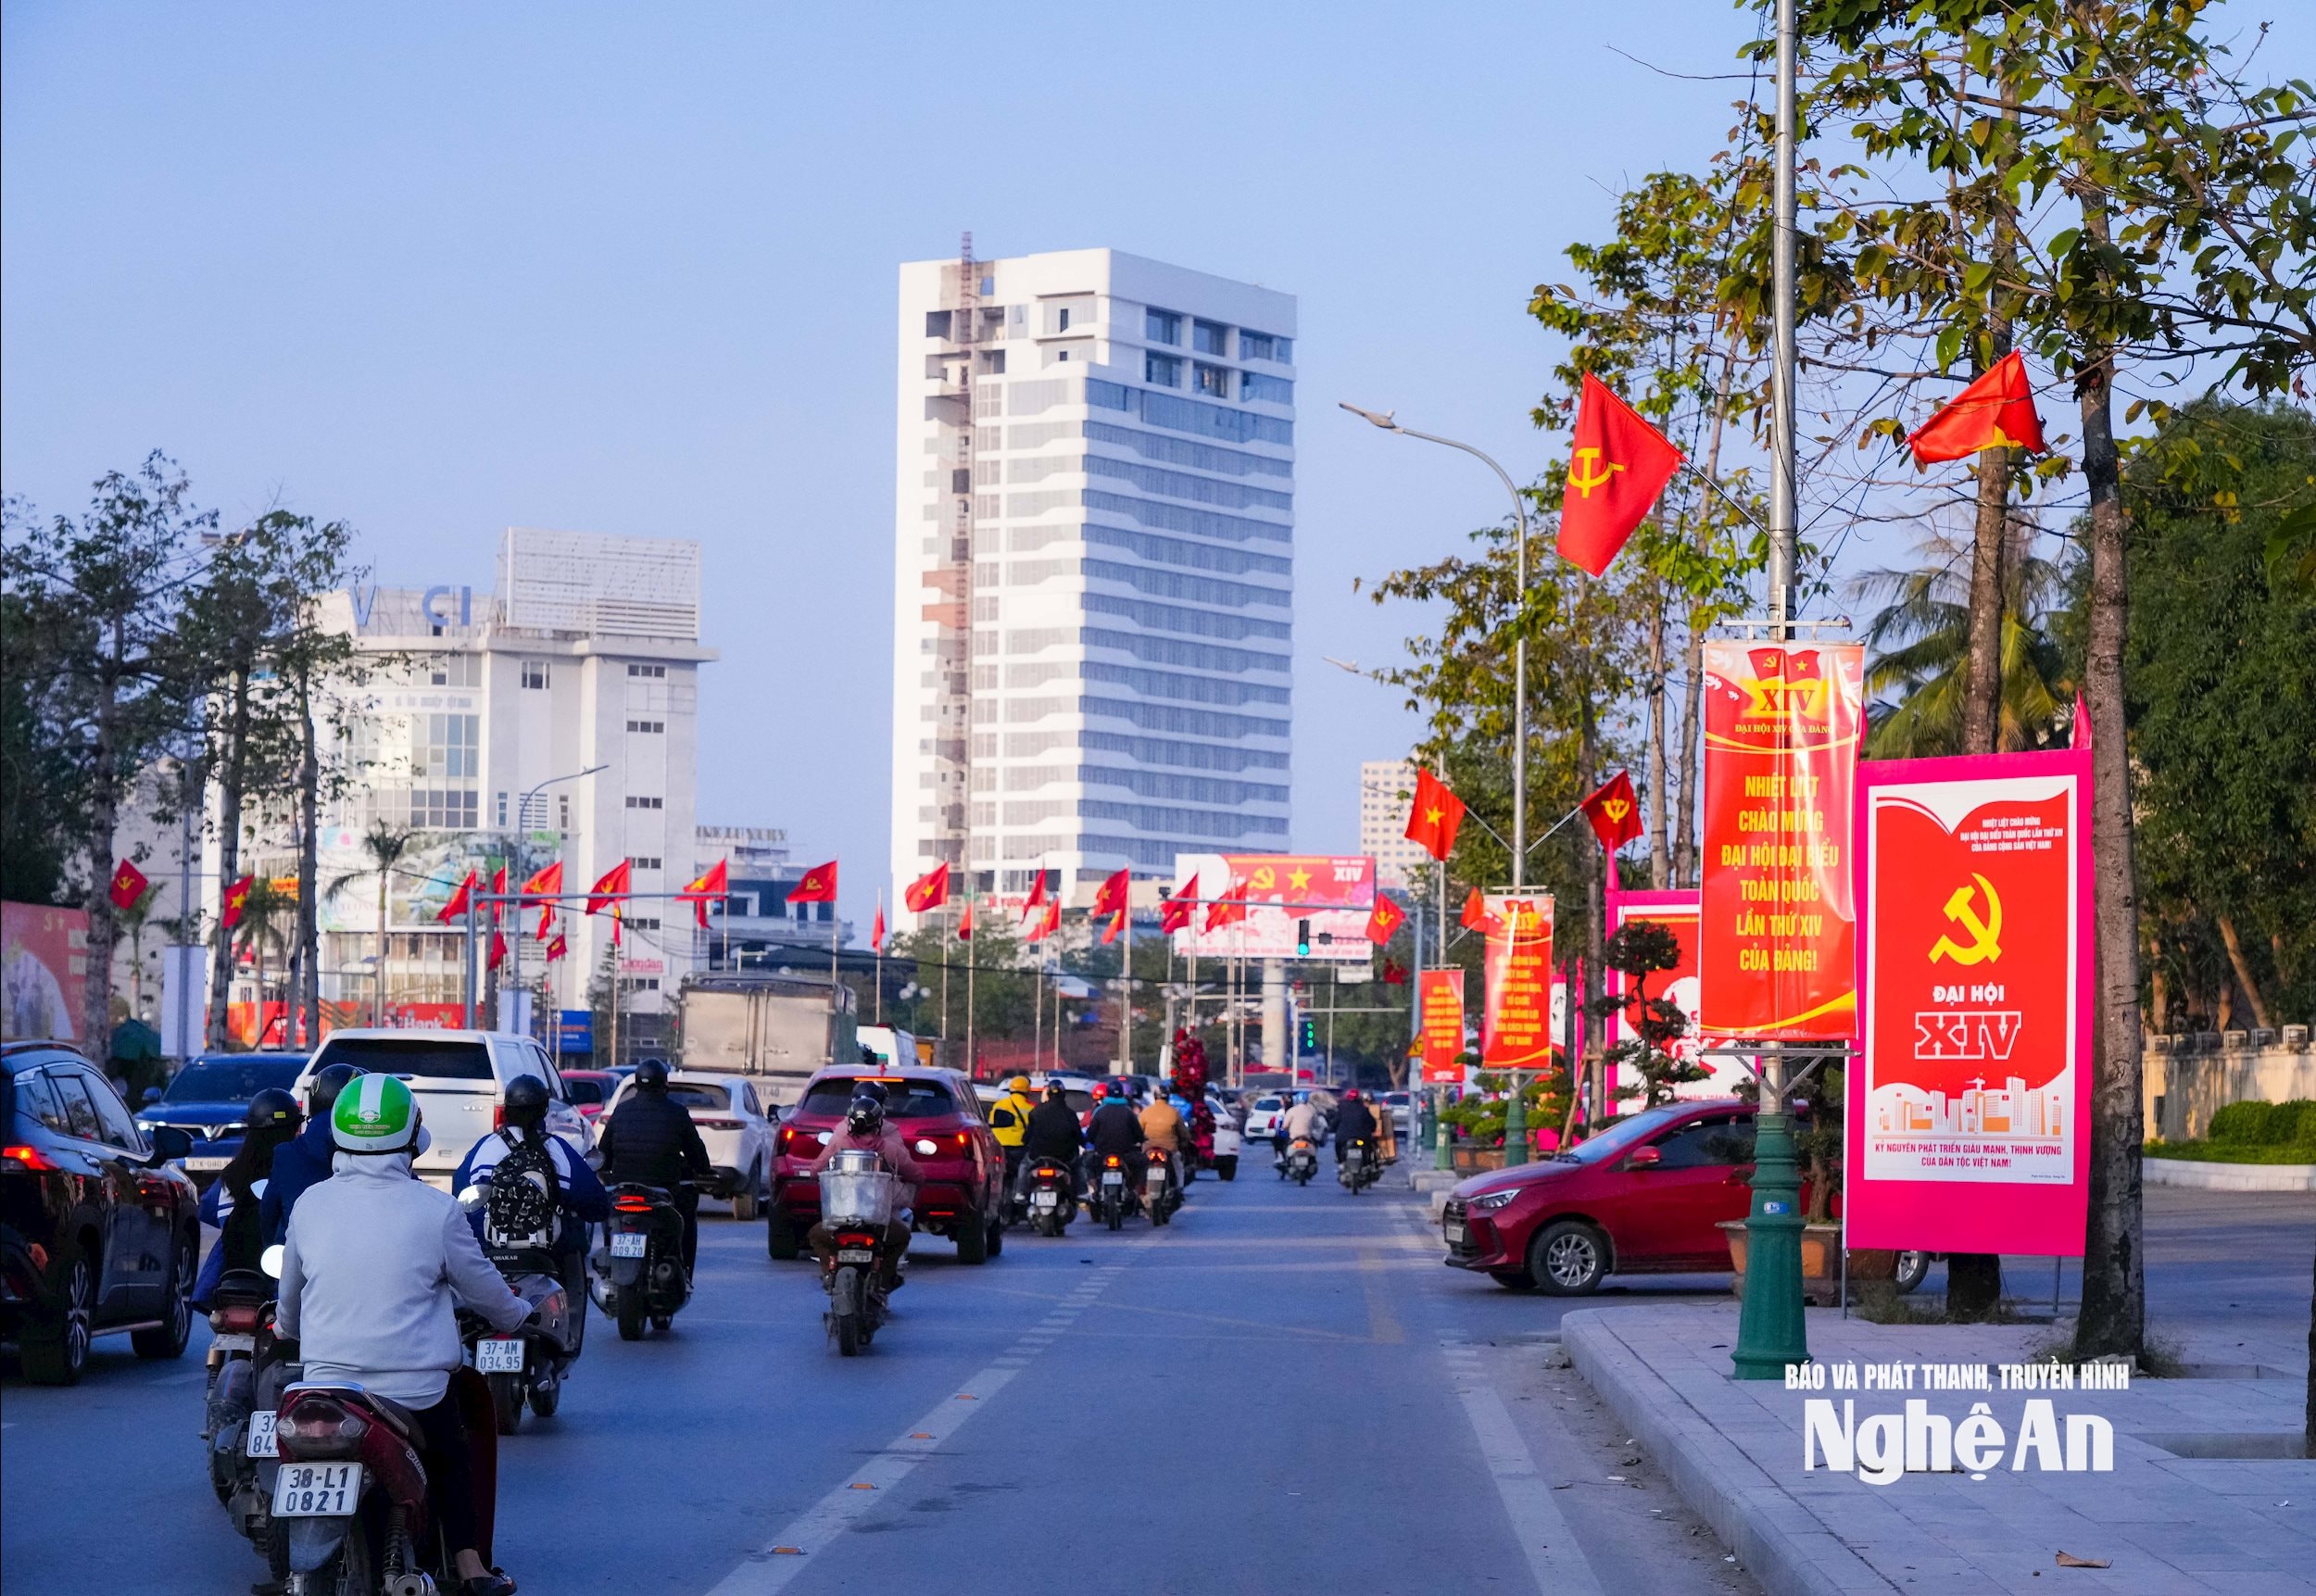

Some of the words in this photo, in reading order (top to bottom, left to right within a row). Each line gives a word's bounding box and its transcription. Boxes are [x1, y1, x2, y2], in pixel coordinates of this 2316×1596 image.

[1760, 689, 1815, 711] XIV
[1735, 724, 1751, 734] ĐẠI
[1754, 723, 1770, 735] HỘI
[1745, 772, 1786, 802] NHIỆT
[1739, 806, 1778, 832] CHÀO
[1721, 845, 1746, 871] ĐẠI
[1751, 841, 1776, 872] HỘI
[1779, 845, 1802, 872] ĐẠI
[1334, 867, 1363, 882] XIV
[1740, 875, 1778, 901] TOÀN
[1781, 873, 1819, 904] QUỐC
[1736, 908, 1765, 936] LẦN
[1769, 911, 1797, 936] THỨ
[1800, 915, 1822, 936] XIV
[1740, 942, 1769, 971] CỦA
[1773, 943, 1817, 972] ĐẢNG!
[1932, 985, 1965, 1006] ĐẠI
[1970, 981, 2005, 1006] HỘI
[1915, 1011, 2021, 1060] XIV
[1875, 1140, 1884, 1152] KỶ
[1887, 1141, 1916, 1152] NGUYÊN
[1919, 1142, 1937, 1152] PHÁT
[1940, 1140, 1960, 1153] TRIỂN
[1963, 1143, 1981, 1153] GIÀU
[1983, 1145, 2008, 1156] MẠNH,
[2010, 1145, 2033, 1156] THỊNH
[2035, 1145, 2061, 1157] VƯỢNG
[1921, 1153, 1936, 1166] CỦA
[1939, 1155, 1954, 1166] DÂN
[1957, 1156, 1970, 1168] TỘC
[1972, 1156, 1988, 1169] VIỆT
[1991, 1158, 2011, 1168] NAM!
[613, 1246, 643, 1256] 009.20
[616, 1235, 641, 1246] 37-AH
[485, 1342, 518, 1355] 37-AM
[480, 1357, 520, 1369] 034.95
[253, 1435, 278, 1453] 84
[289, 1467, 348, 1489] 38-L1
[285, 1490, 345, 1512] 0821
